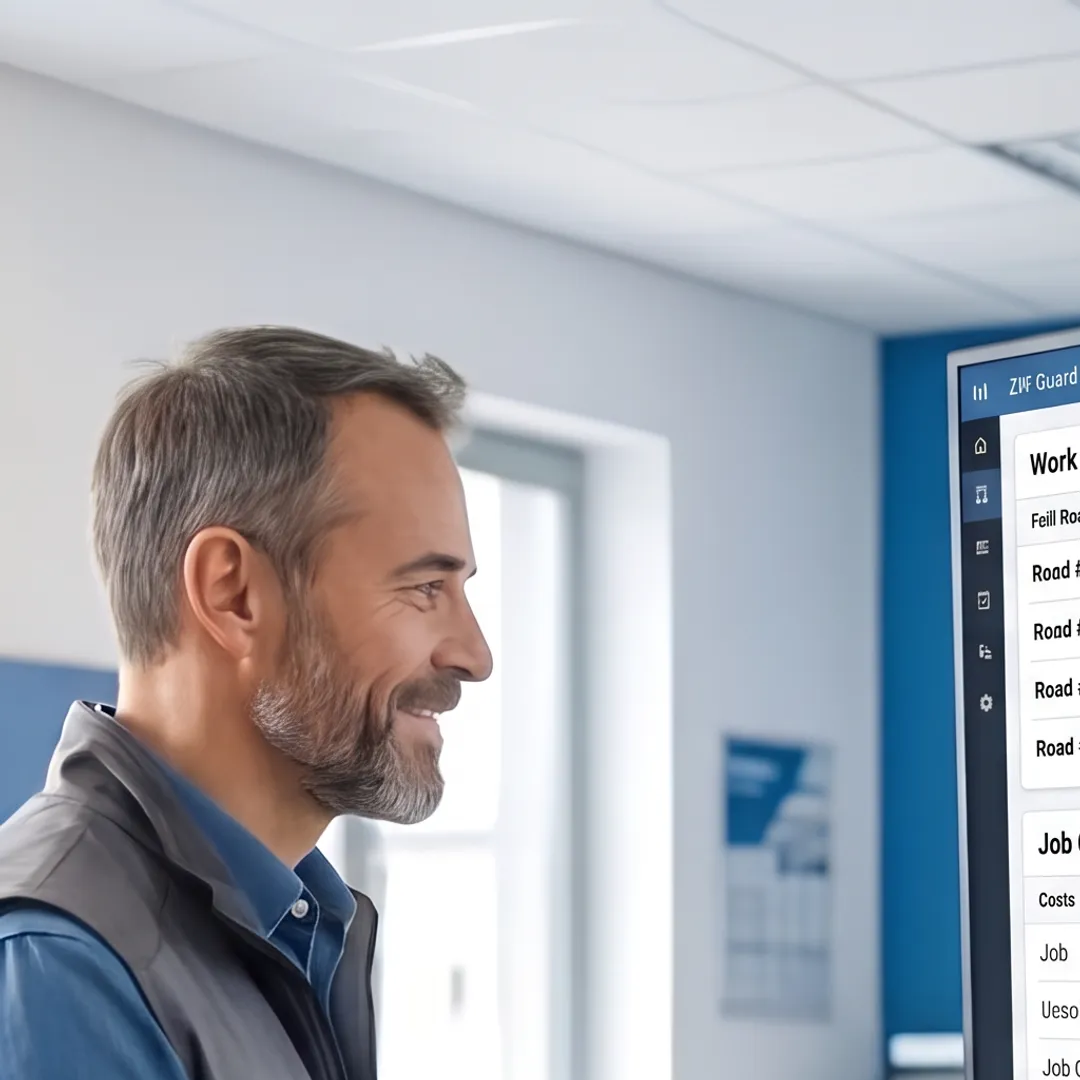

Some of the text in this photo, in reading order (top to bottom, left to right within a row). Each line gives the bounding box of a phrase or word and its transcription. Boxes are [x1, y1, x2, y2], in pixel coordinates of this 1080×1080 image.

[1036, 366, 1077, 390] Guard
[1030, 448, 1078, 475] Work
[1032, 510, 1056, 528] Feill
[1033, 560, 1070, 582] Road
[1034, 619, 1071, 641] Road
[1035, 678, 1073, 699] Road
[1036, 737, 1074, 757] Road
[1038, 830, 1072, 855] Job
[1039, 892, 1075, 908] Costs
[1040, 943, 1068, 962] Job
[1042, 1058, 1070, 1077] Job
